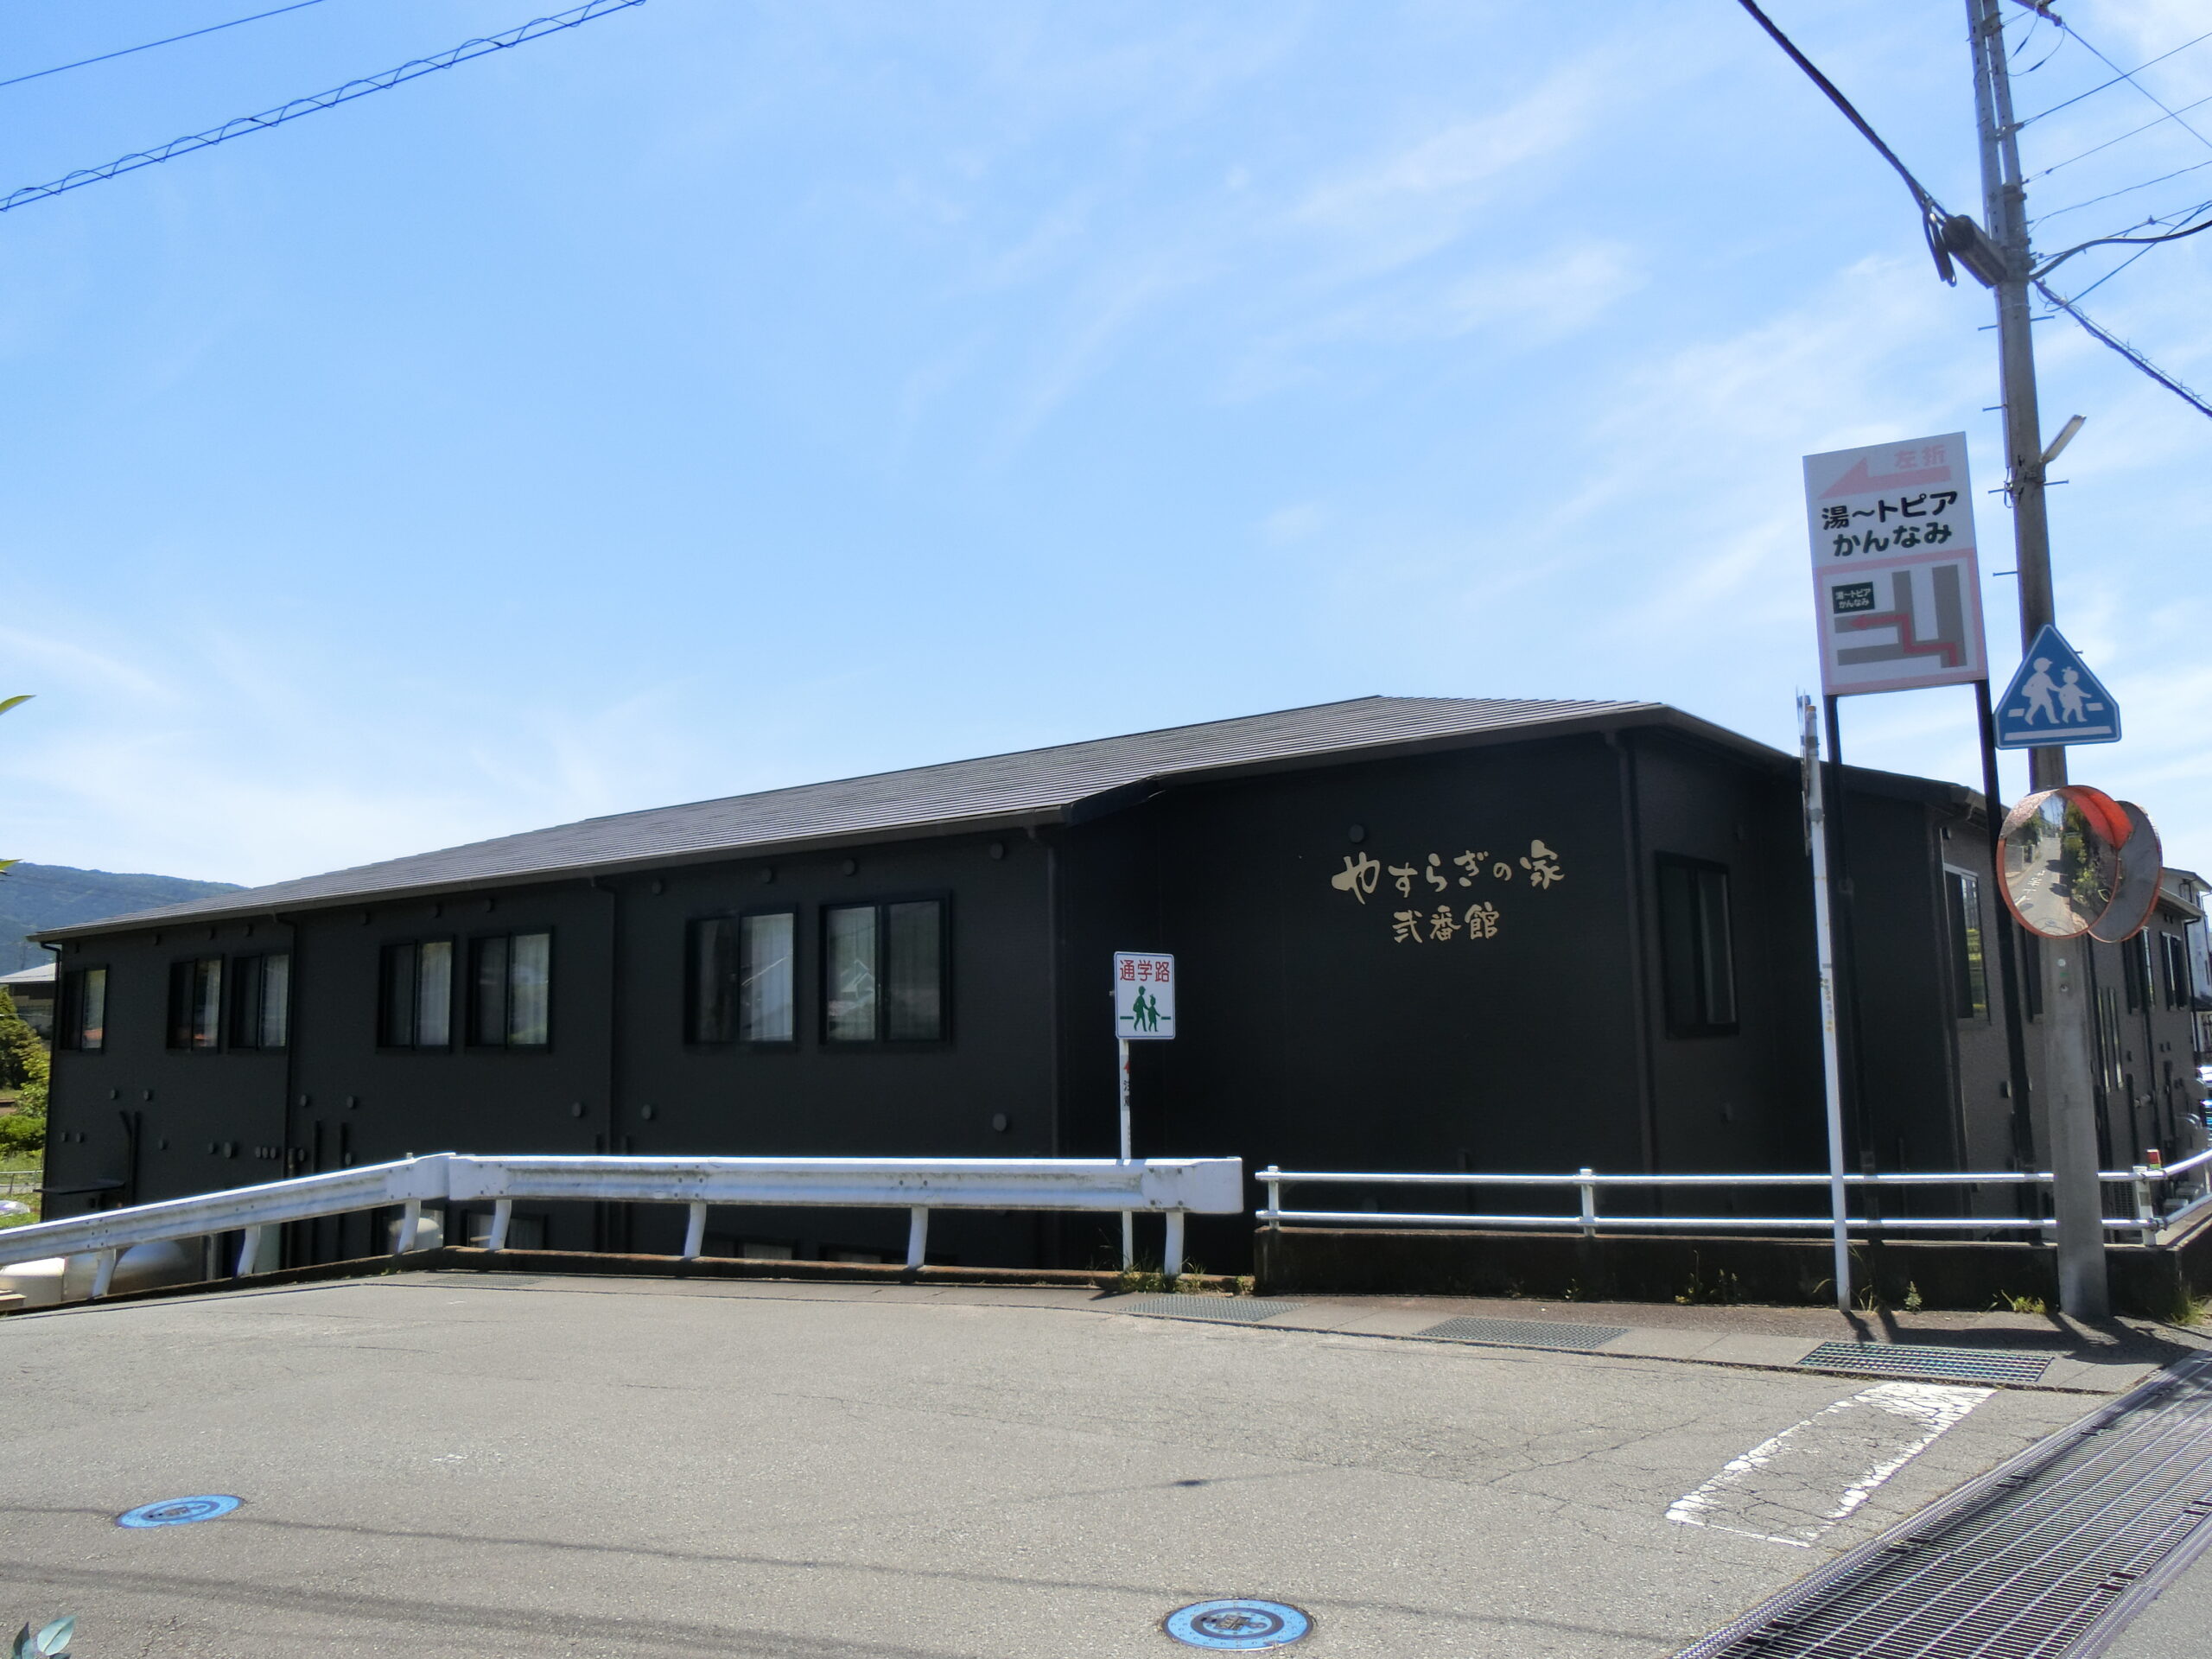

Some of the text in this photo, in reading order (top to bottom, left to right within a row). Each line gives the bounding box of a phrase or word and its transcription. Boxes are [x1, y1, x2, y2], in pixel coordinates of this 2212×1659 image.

[1894, 444, 1946, 469] 左折
[1833, 522, 1953, 557] かんなみ
[1331, 839, 1565, 905] やすらぎの家
[1120, 959, 1170, 982] 通学路
